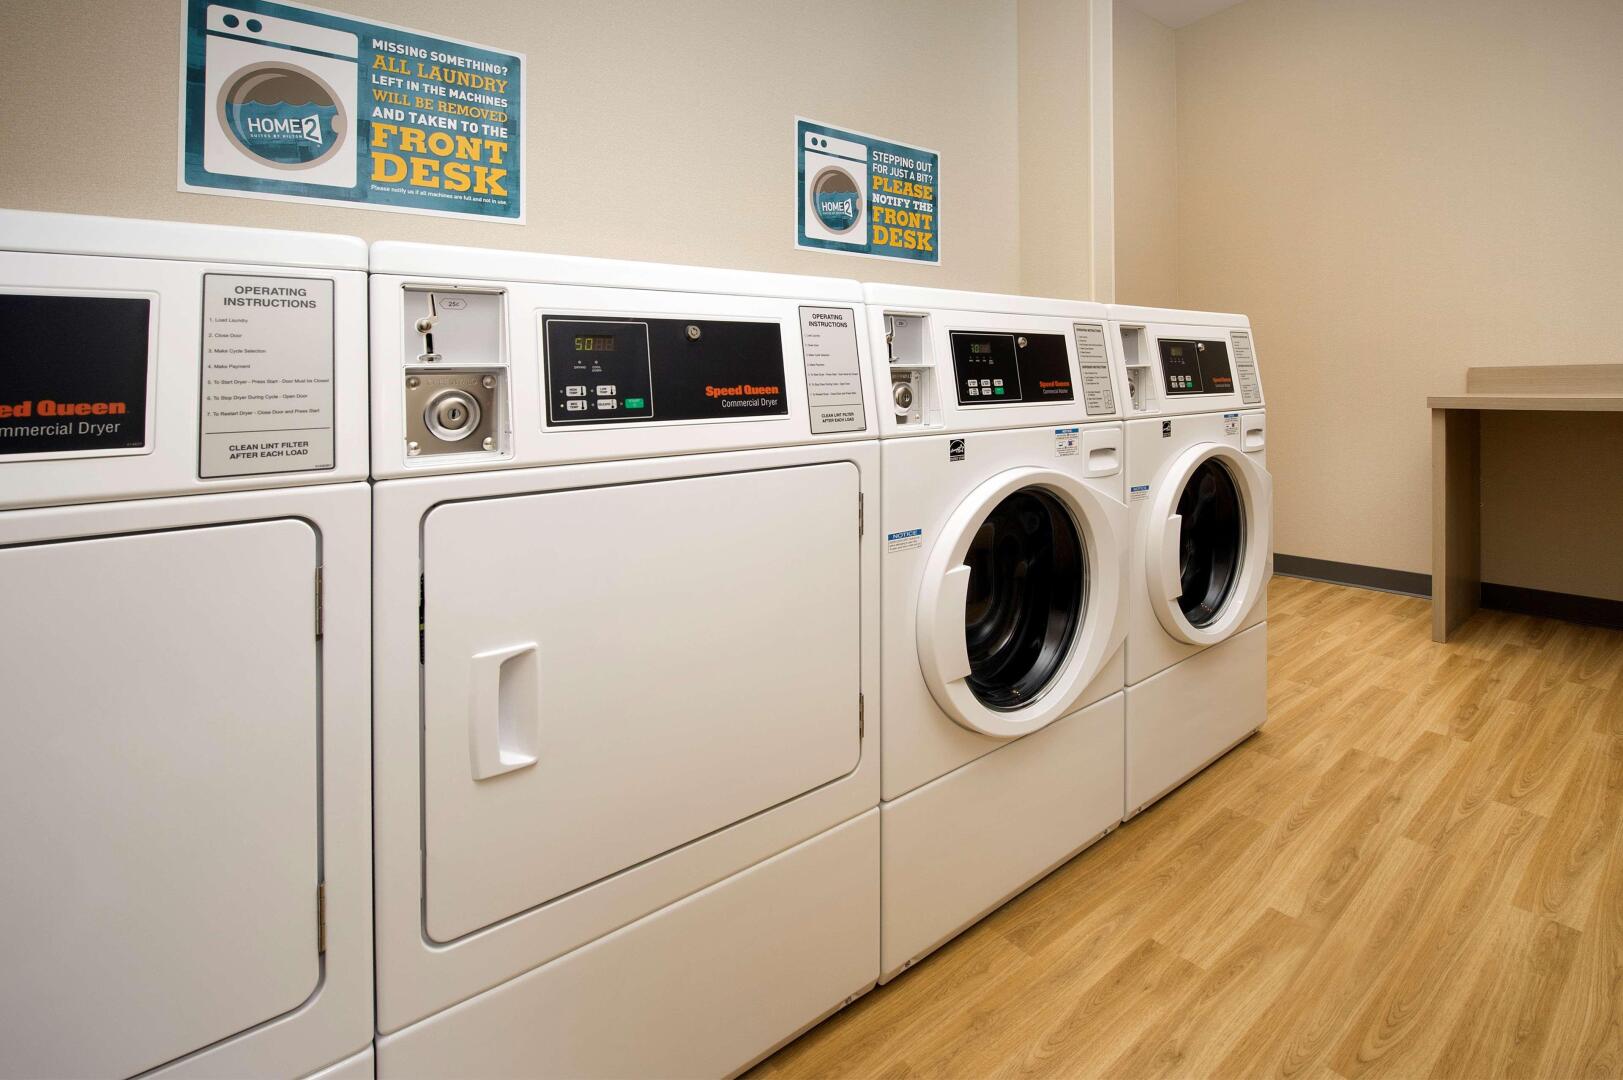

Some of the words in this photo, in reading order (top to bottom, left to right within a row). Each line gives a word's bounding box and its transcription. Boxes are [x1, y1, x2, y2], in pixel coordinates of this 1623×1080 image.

[372, 39, 427, 59] MISSING
[430, 51, 508, 76] SOMETHING?
[372, 54, 411, 75] ALL
[417, 63, 508, 94] LAUNDRY
[372, 74, 403, 88] LEFT
[407, 80, 419, 91] IN
[423, 83, 446, 96] THE
[449, 88, 508, 108] MACHINES
[372, 89, 410, 106] WILL
[415, 96, 434, 110] BE
[438, 101, 508, 123] REMOVED
[372, 106, 404, 121] AND
[408, 112, 457, 130] TAKEN
[461, 121, 478, 133] TO
[482, 124, 508, 138] THE
[371, 122, 508, 164] FRONT
[873, 151, 914, 169] STEPPING
[916, 161, 932, 172] OUT
[371, 152, 508, 196] DESK
[873, 163, 888, 175] FOR
[890, 167, 909, 178] JUST
[910, 171, 915, 180] A
[917, 173, 933, 184] BIT?
[371, 184, 390, 192] Please
[391, 187, 406, 195] notify
[428, 191, 453, 199] machines
[873, 175, 932, 200] PLEASE
[872, 193, 910, 208] NOTIFY
[913, 200, 933, 212] THE
[873, 205, 932, 230] FRONT
[873, 224, 932, 251] DESK
[234, 285, 307, 296] OPERATING
[223, 297, 317, 308] INSTRUCTIONS
[705, 385, 742, 398] Speed
[744, 385, 779, 395] Queen
[37, 400, 126, 416] Queen
[722, 399, 759, 408] Commercial
[761, 398, 778, 407] Dryer
[78, 421, 121, 436] Dryer
[229, 444, 258, 452] CLEAN
[229, 452, 258, 460] AFTER
[892, 530, 917, 540] NOTICE
